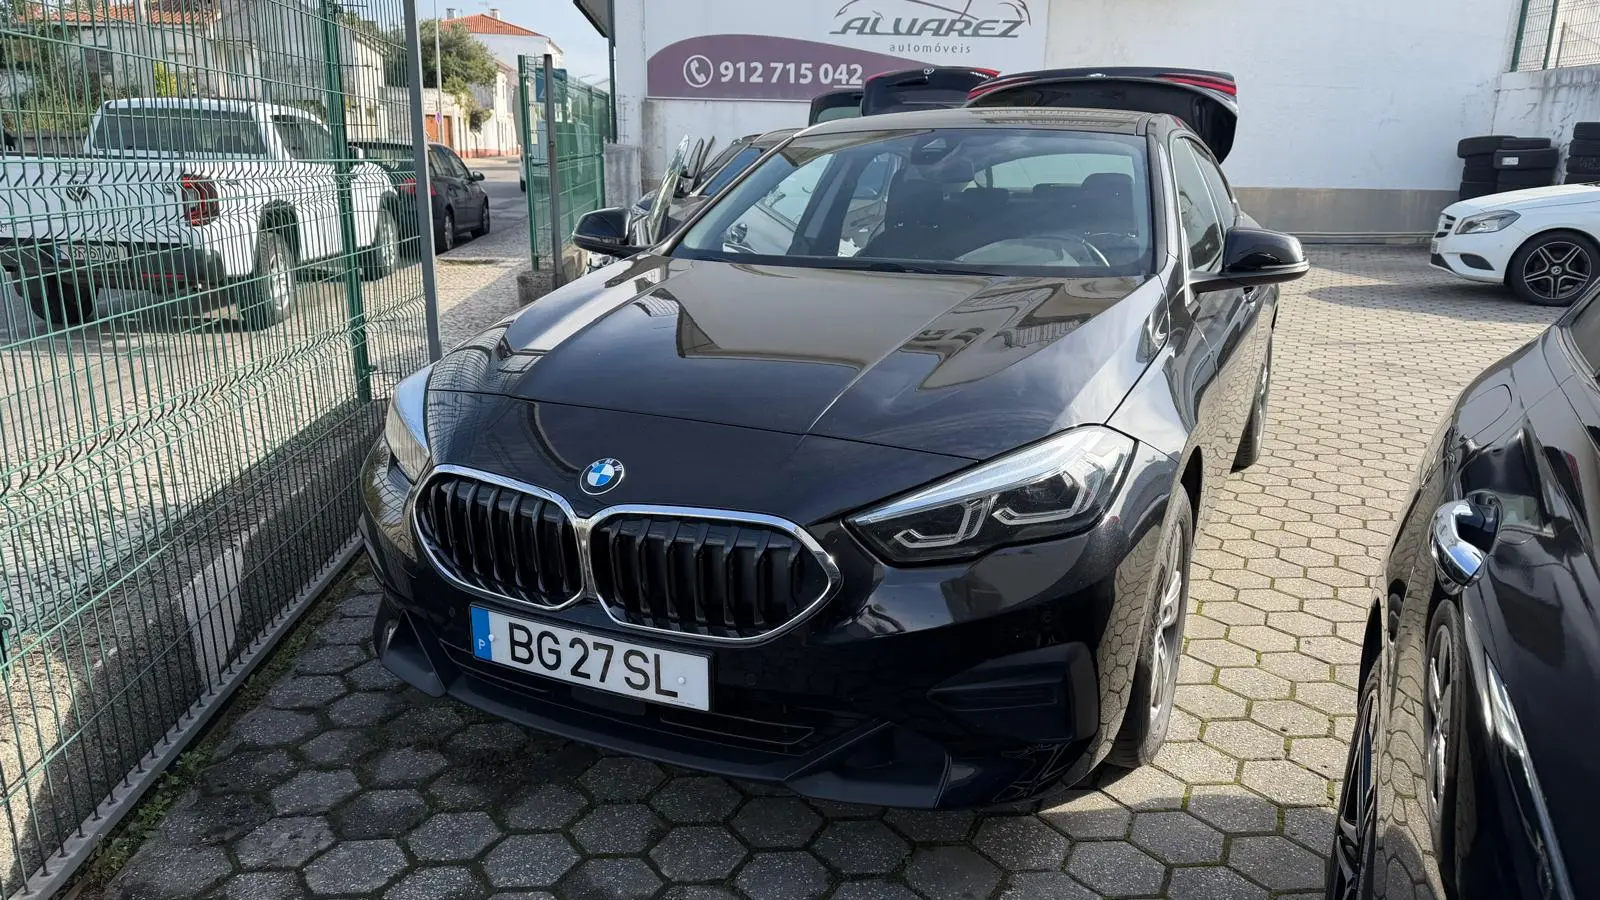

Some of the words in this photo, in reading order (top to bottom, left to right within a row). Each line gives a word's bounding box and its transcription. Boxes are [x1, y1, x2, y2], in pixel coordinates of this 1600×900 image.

[889, 43, 971, 54] automóveis
[719, 61, 763, 83] 912
[770, 62, 813, 84] 715
[819, 63, 863, 85] 042
